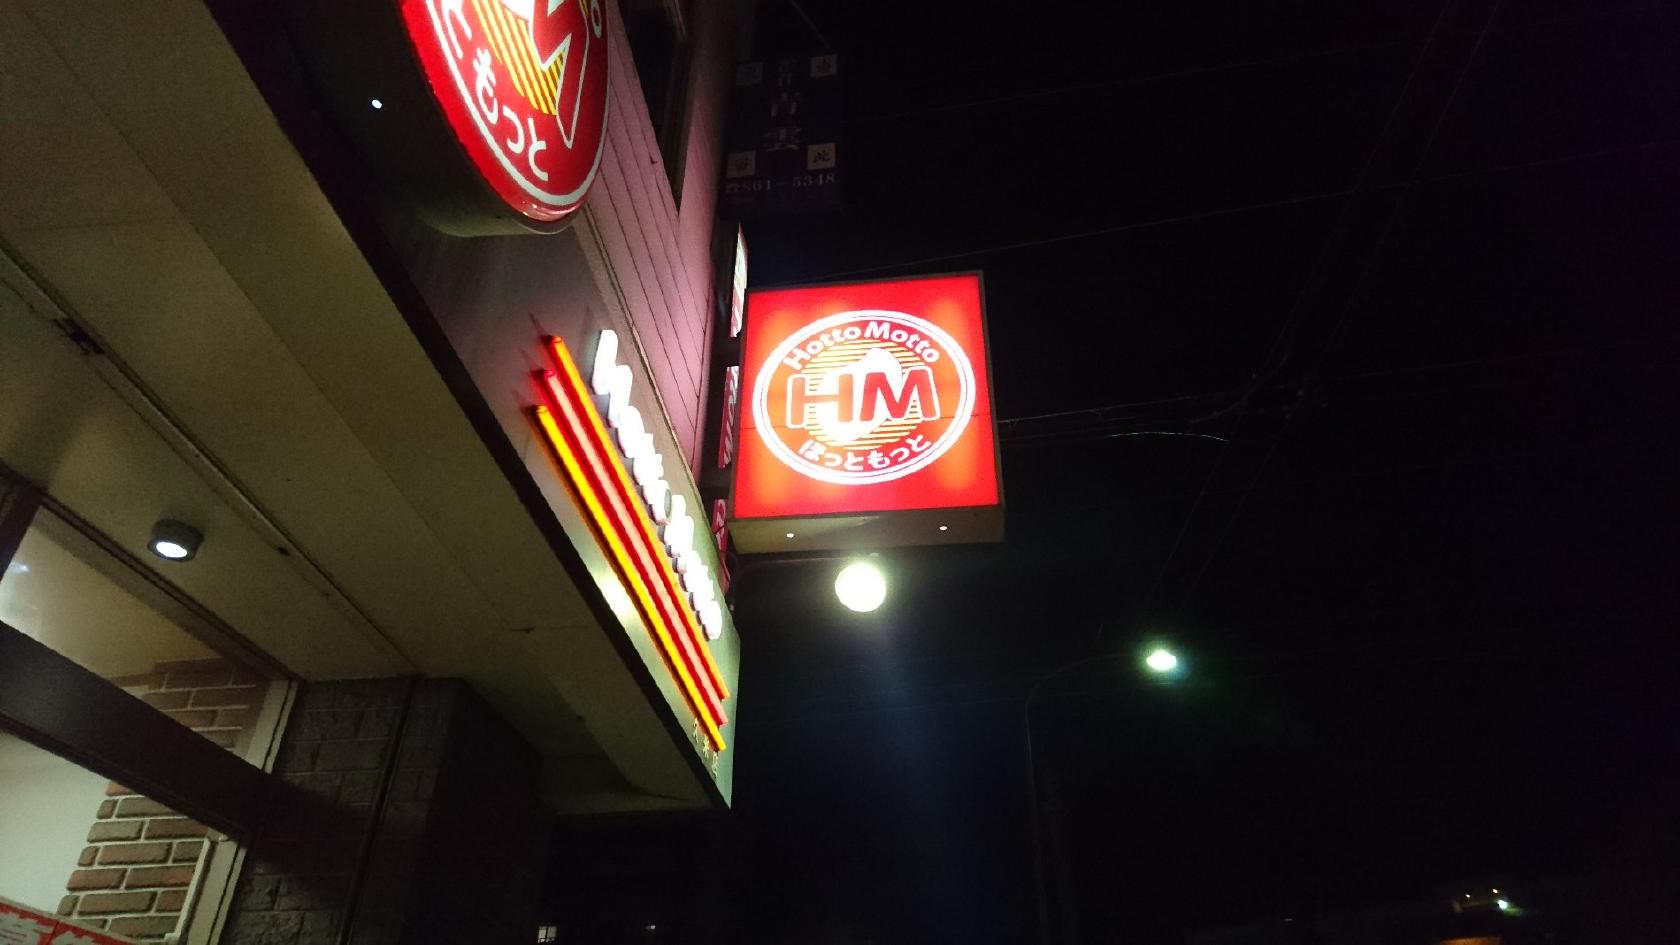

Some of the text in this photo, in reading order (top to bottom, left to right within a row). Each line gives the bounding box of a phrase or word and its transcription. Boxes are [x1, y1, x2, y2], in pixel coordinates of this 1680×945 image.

[783, 320, 940, 370] Hotto Motto
[786, 365, 941, 429] HM
[798, 434, 932, 471] ほっともっと
